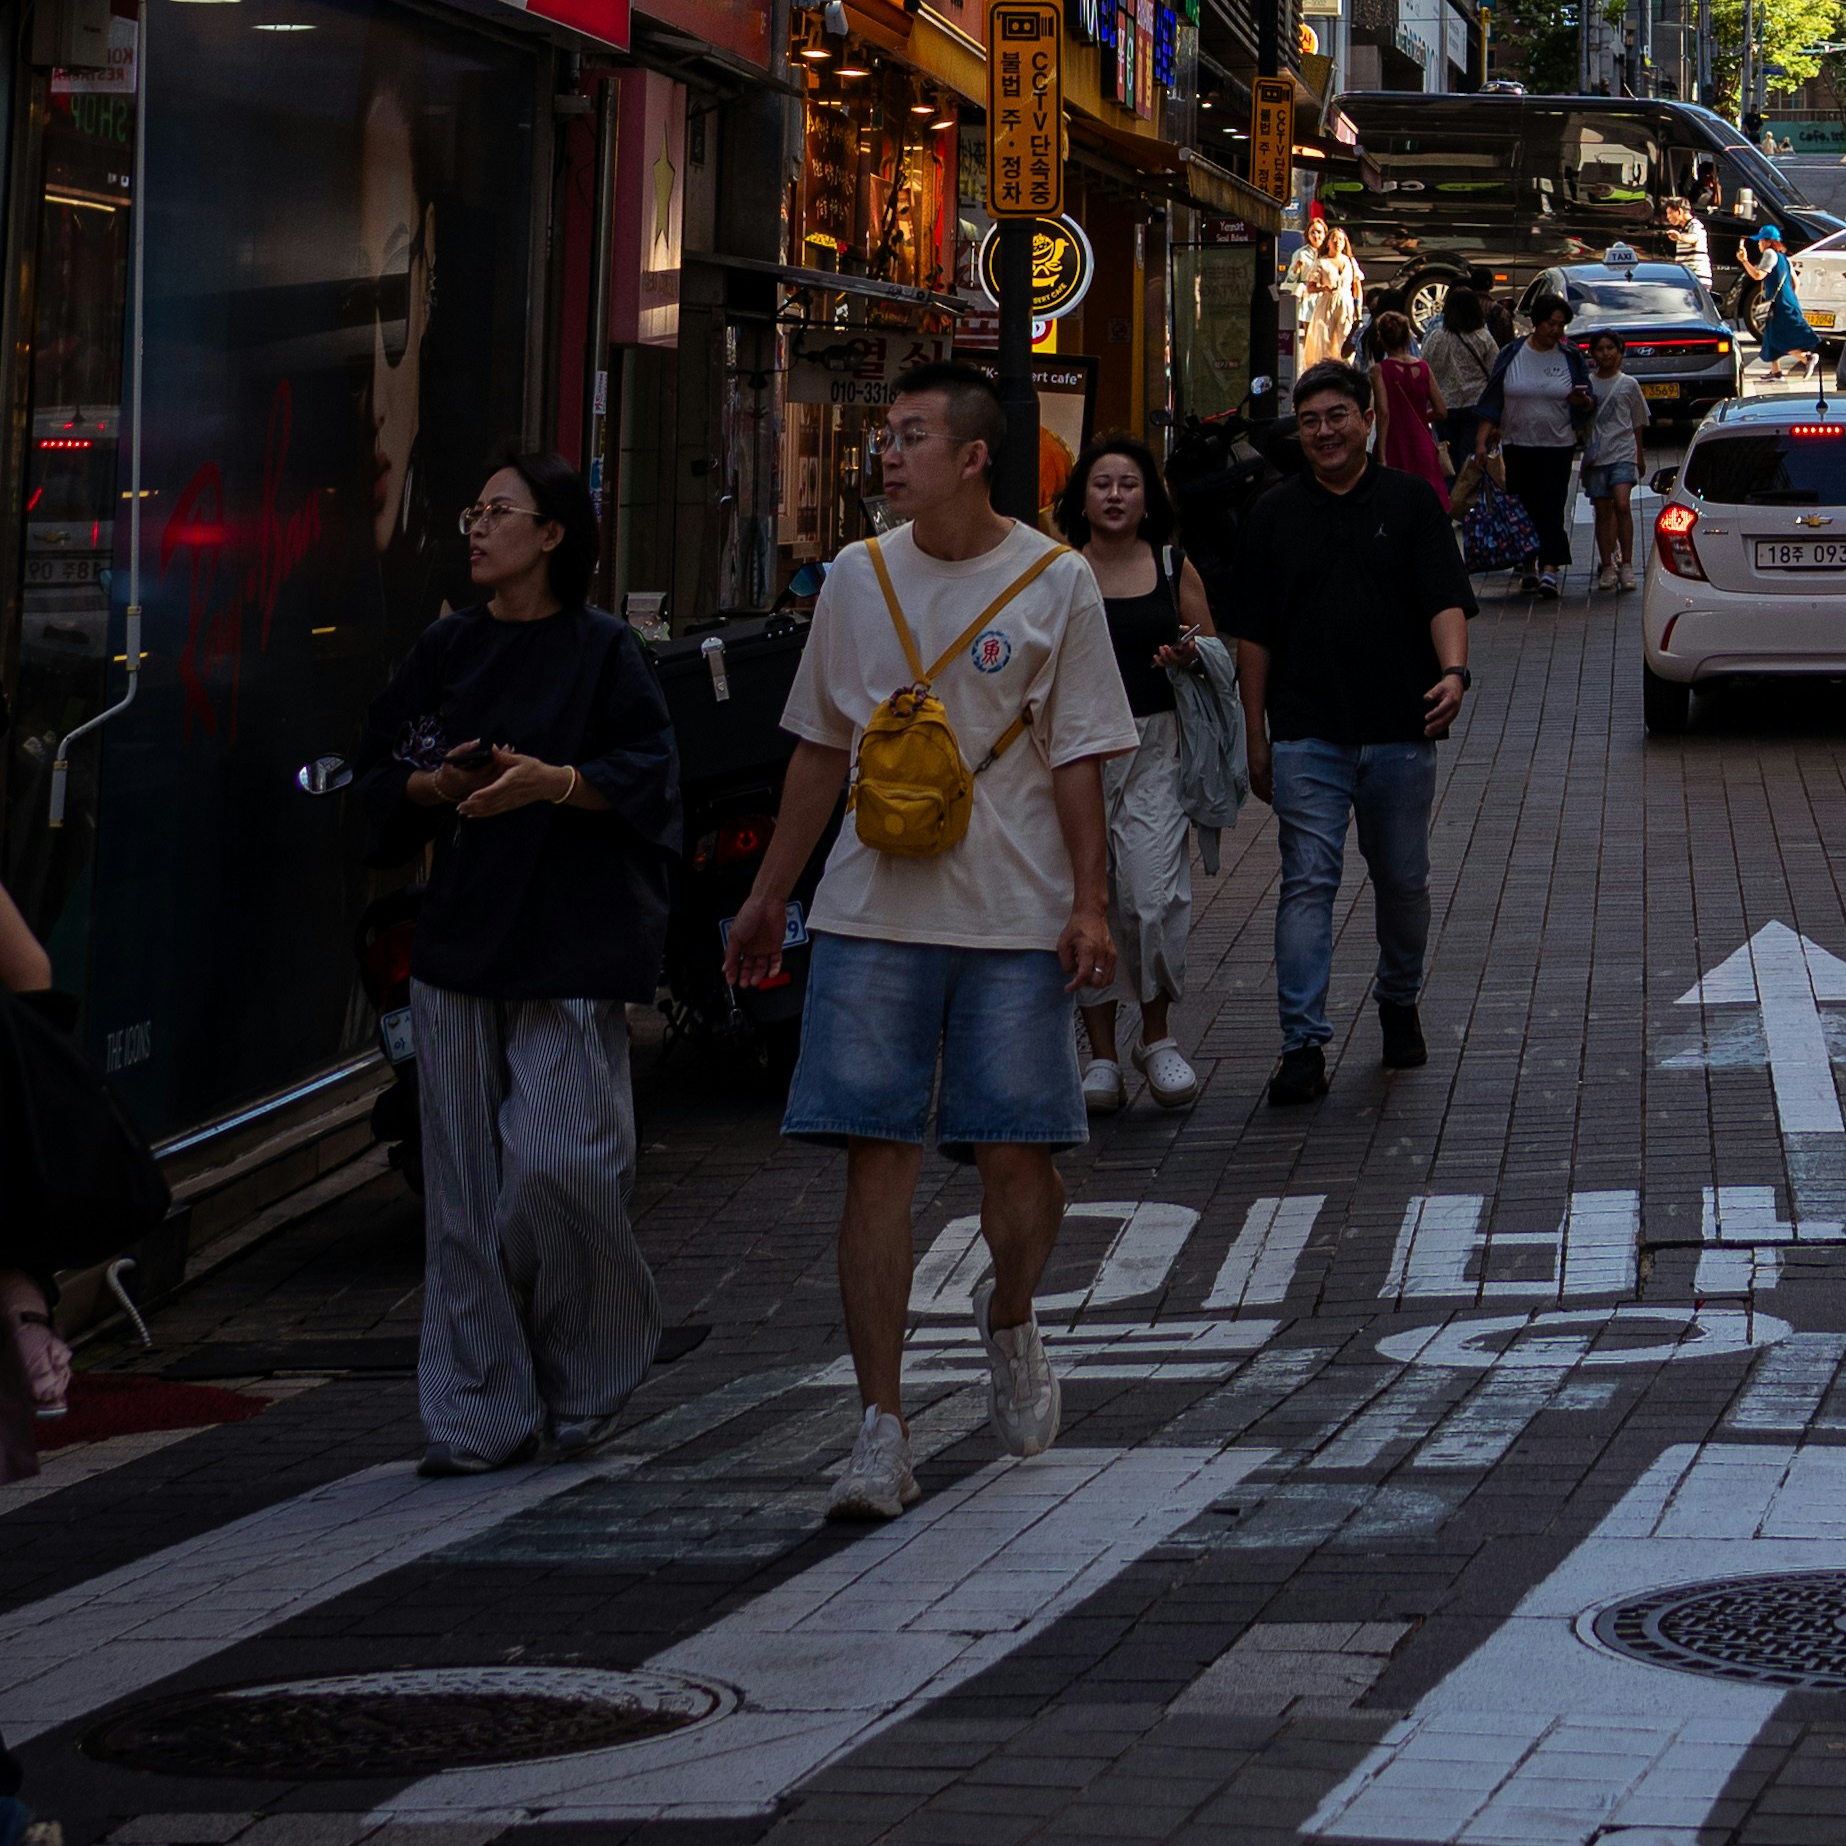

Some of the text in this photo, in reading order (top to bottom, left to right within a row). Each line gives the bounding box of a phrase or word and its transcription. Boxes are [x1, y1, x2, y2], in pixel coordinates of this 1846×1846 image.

[1001, 50, 1022, 99] 불법
[1030, 52, 1051, 205] CCTV단속중
[1768, 546, 1803, 563] 18주
[107, 1020, 152, 1073] THE ICONS
